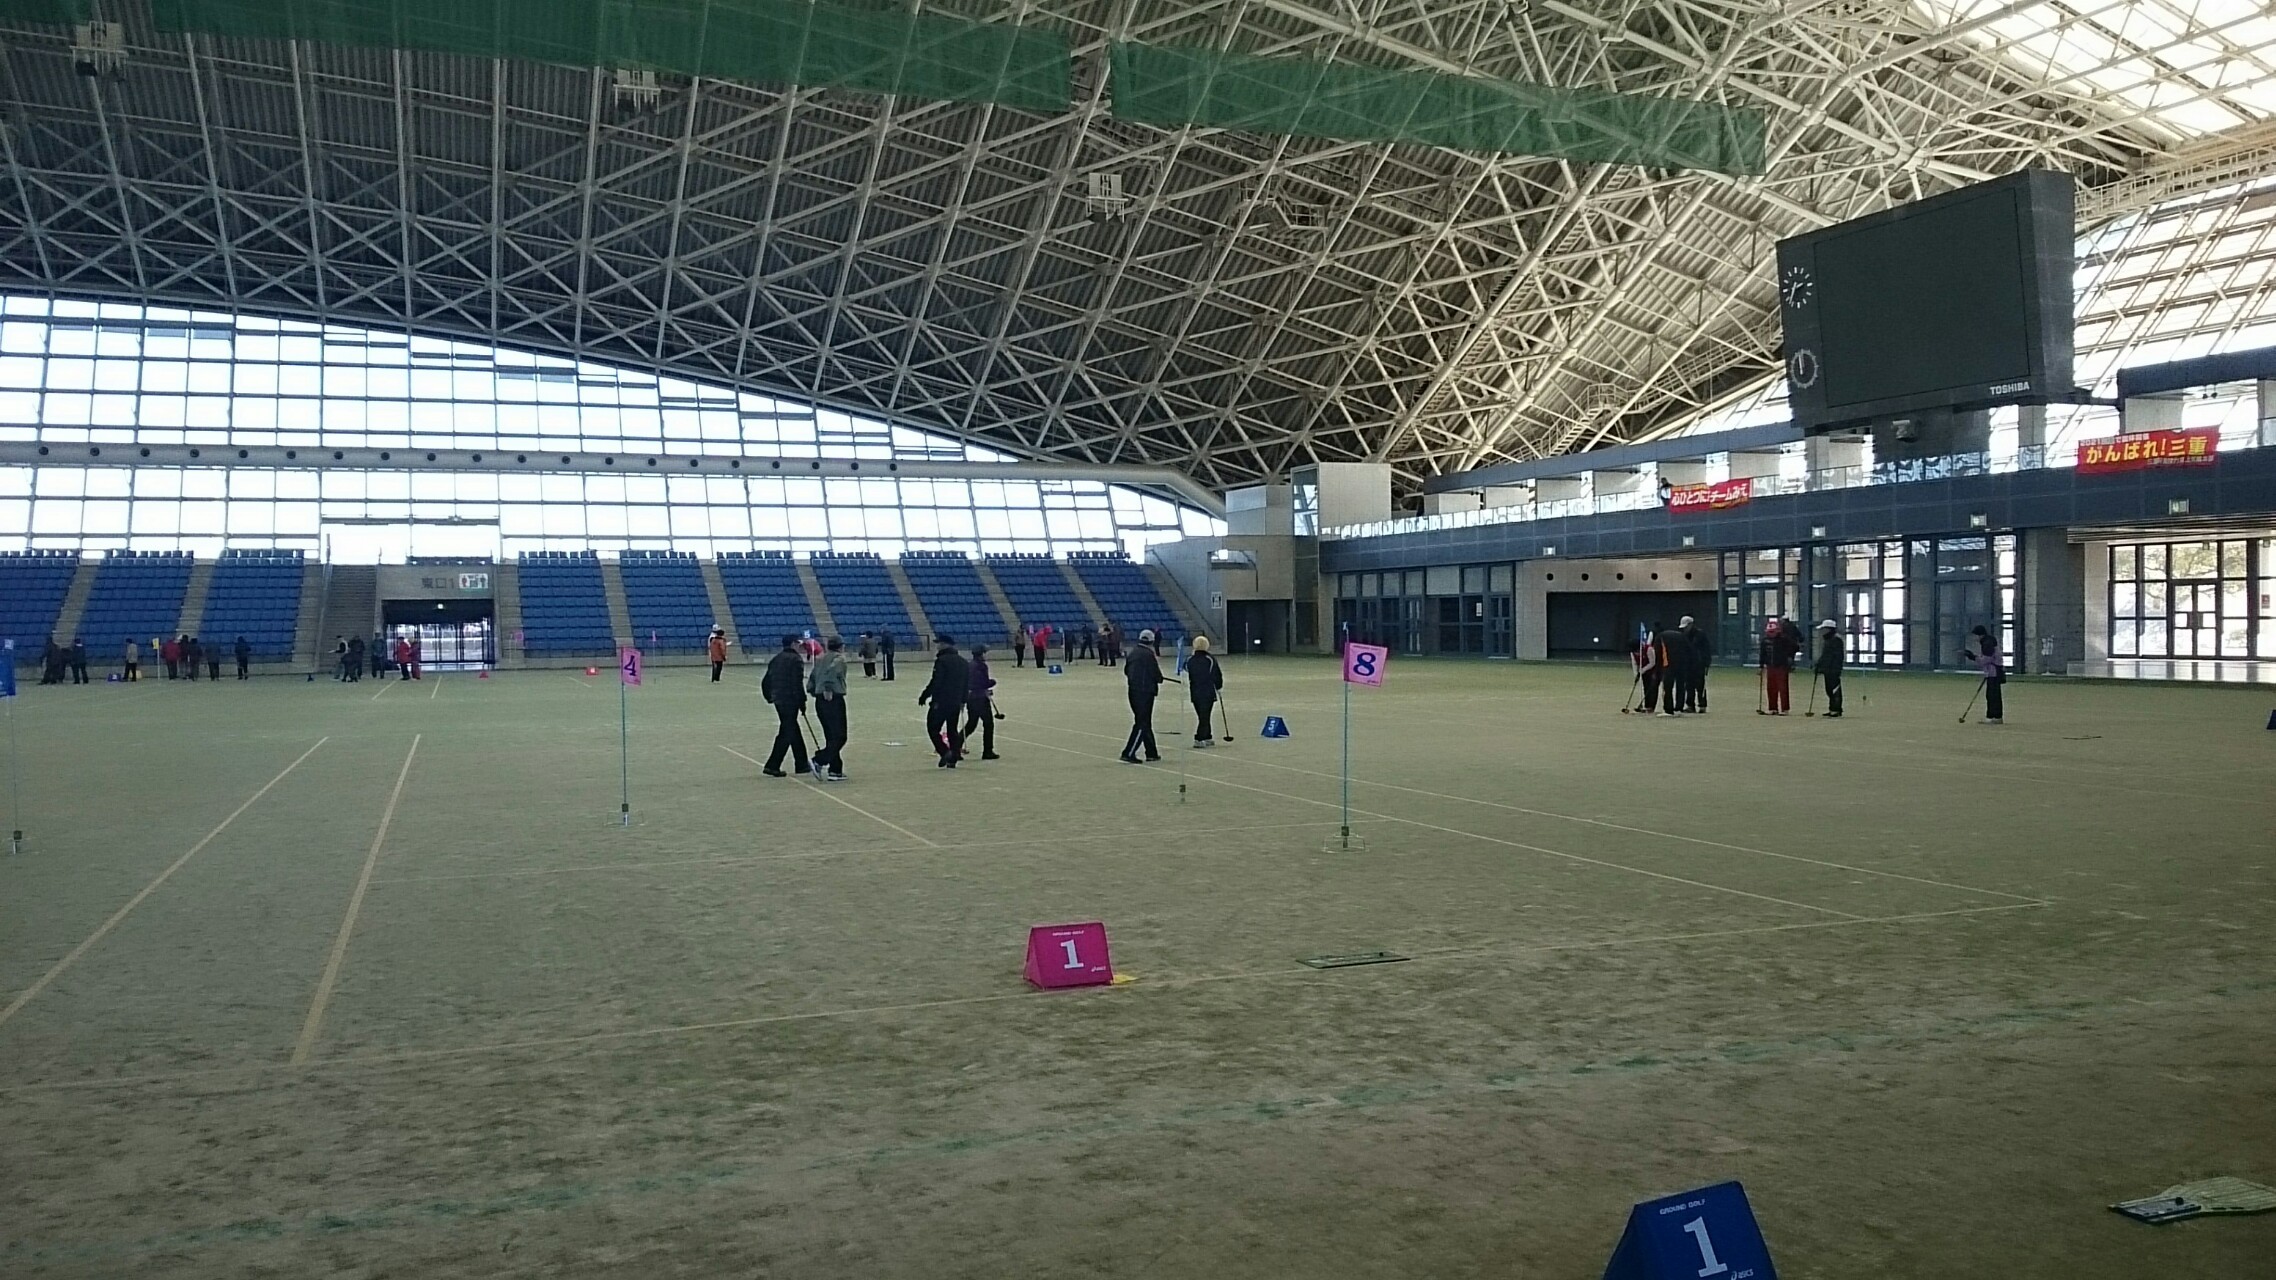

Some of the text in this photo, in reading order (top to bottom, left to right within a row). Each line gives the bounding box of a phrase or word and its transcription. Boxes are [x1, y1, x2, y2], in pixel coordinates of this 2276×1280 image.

[1989, 381, 2030, 395] TOSHIBA
[2086, 436, 2208, 464] がんばれ!三重
[624, 655, 637, 676] 4
[1353, 652, 1376, 676] 8
[1268, 720, 1276, 731] 5
[1060, 939, 1084, 969] 1
[1659, 1198, 1706, 1215] GROUND GOLF
[1683, 1216, 1728, 1278] 1
